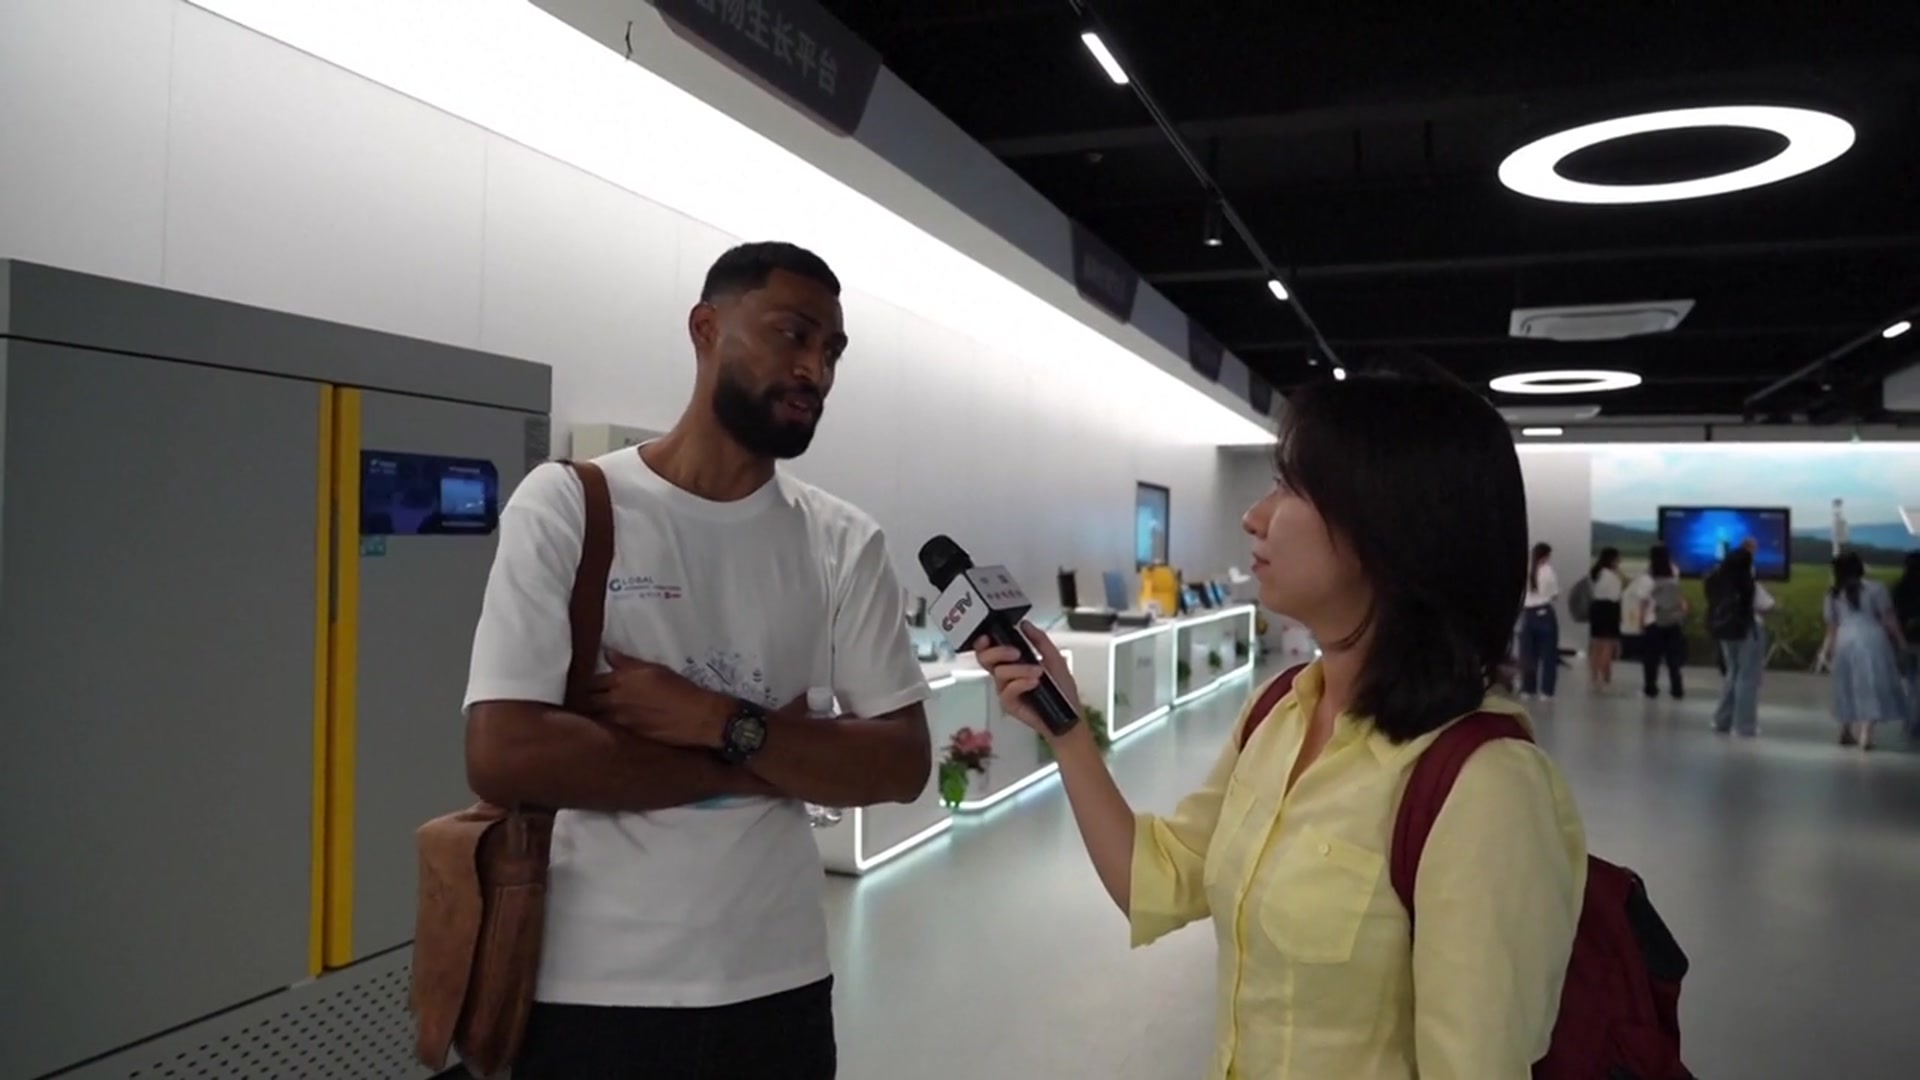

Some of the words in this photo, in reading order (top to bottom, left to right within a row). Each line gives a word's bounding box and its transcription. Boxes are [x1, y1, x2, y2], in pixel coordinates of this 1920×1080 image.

[696, 0, 838, 96] 物生长平台
[609, 576, 654, 592] GLOBAL
[942, 591, 972, 632] CCTV
